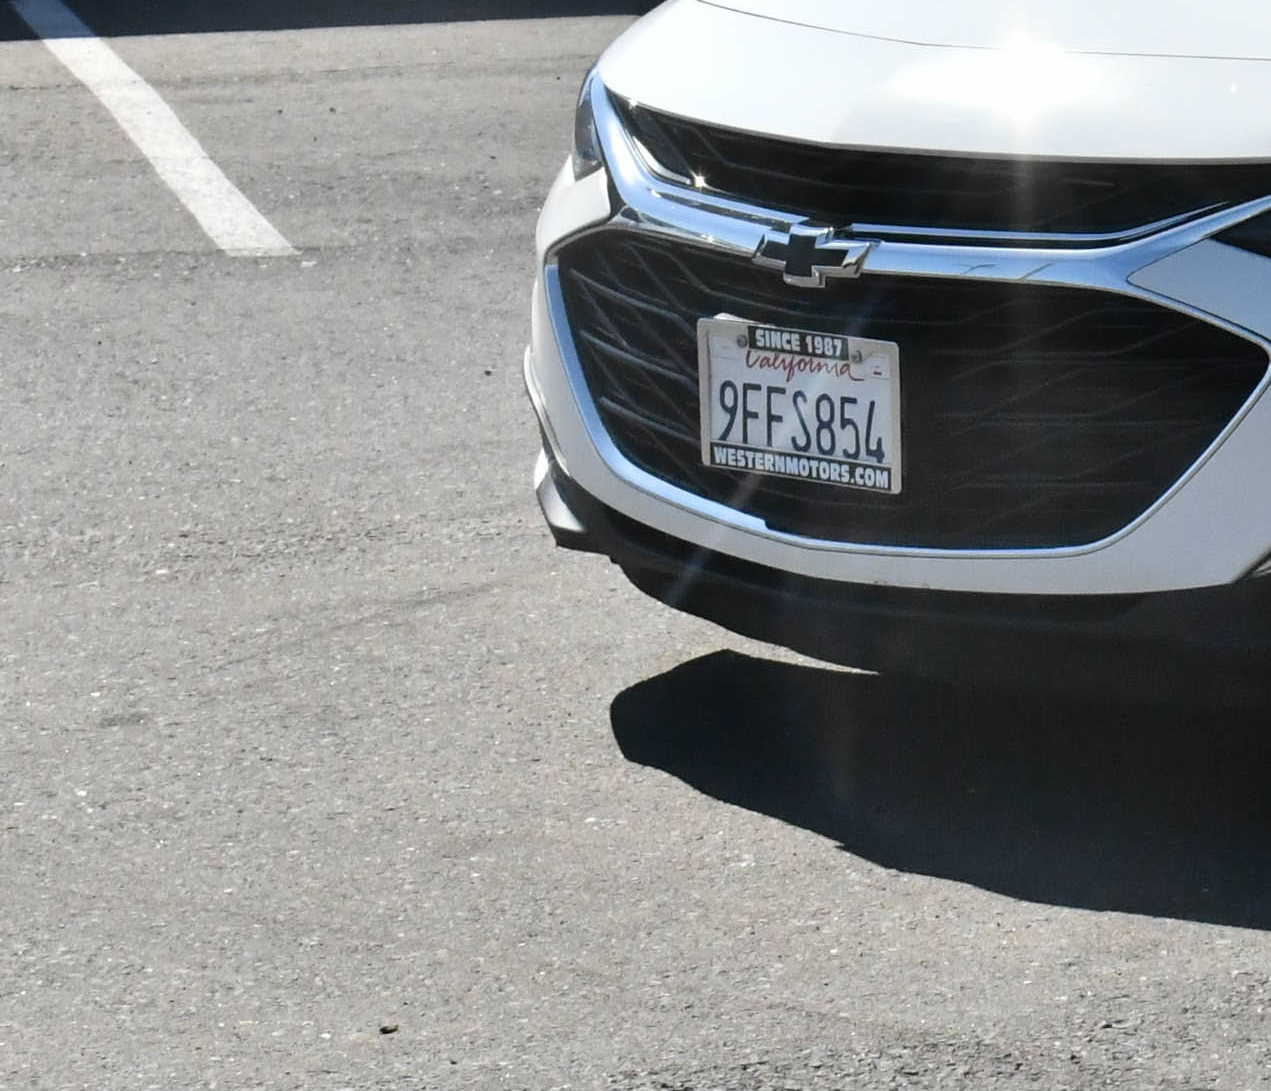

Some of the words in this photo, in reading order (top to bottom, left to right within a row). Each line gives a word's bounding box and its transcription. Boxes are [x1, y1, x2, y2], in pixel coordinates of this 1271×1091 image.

[755, 328, 801, 350] SINCE
[804, 335, 842, 356] 1987
[746, 350, 864, 382] California
[718, 380, 885, 463] 9FFS854
[714, 447, 888, 488] WESTERNMOTORS.COM
